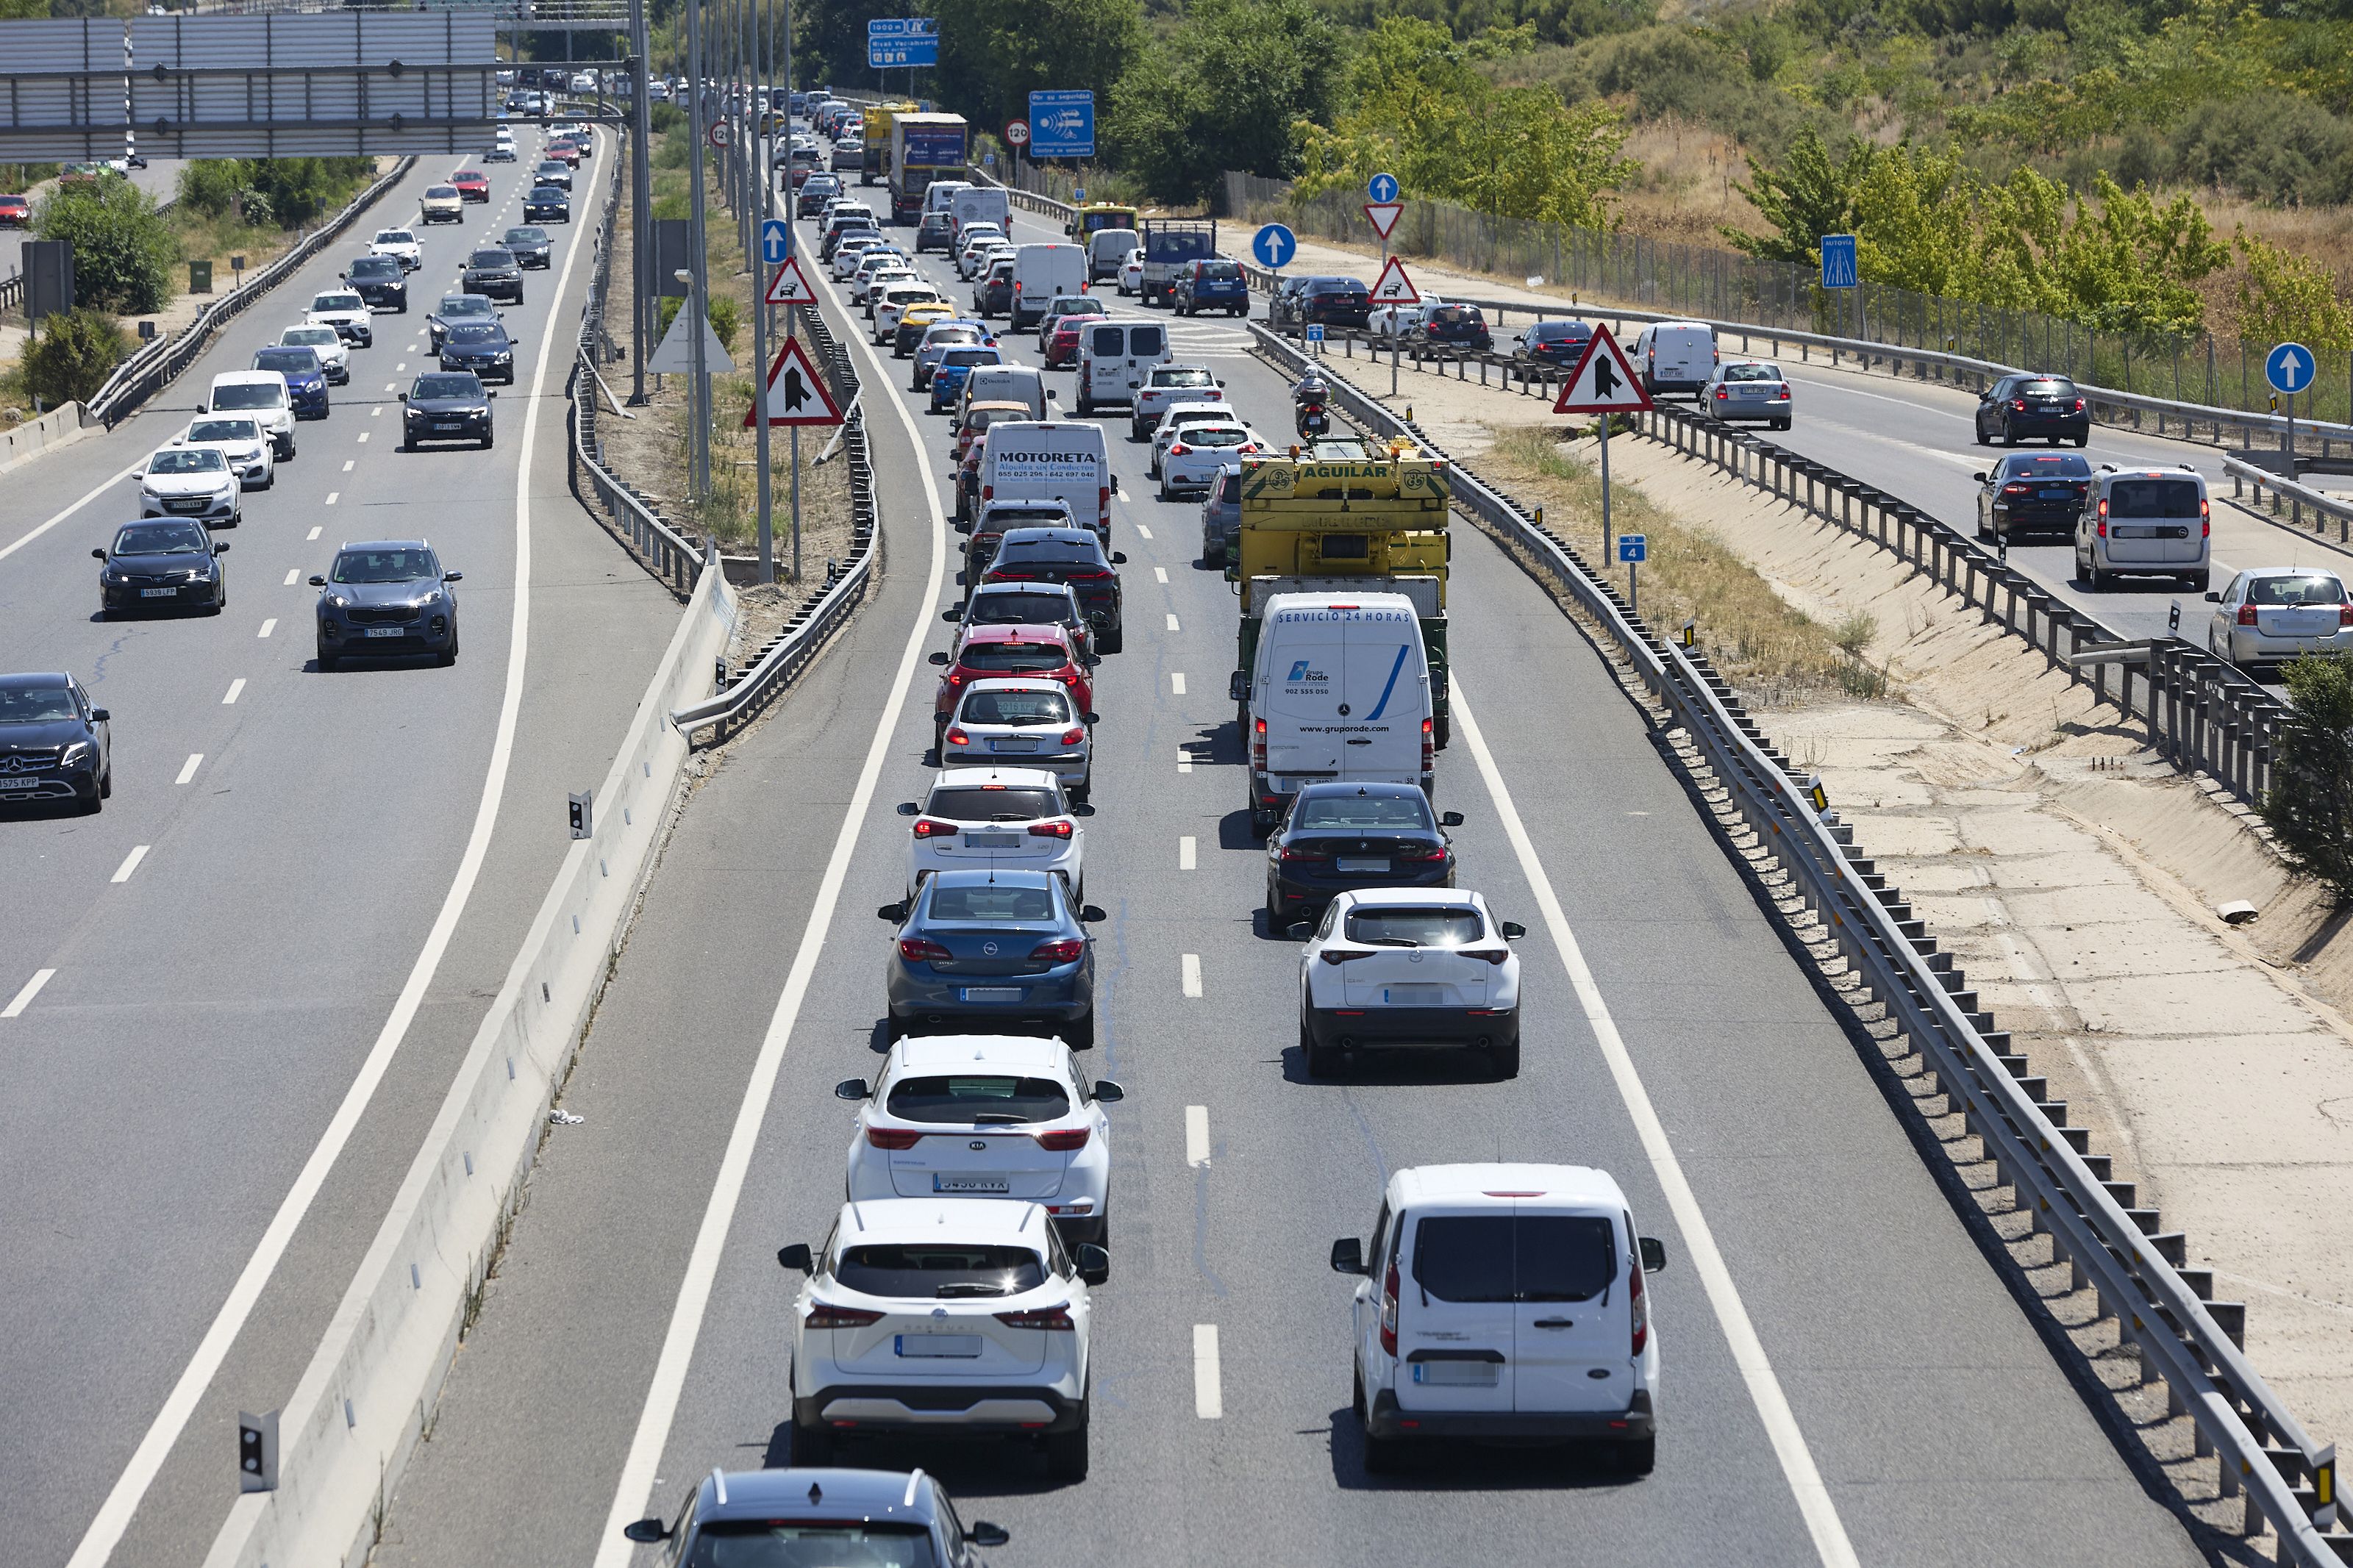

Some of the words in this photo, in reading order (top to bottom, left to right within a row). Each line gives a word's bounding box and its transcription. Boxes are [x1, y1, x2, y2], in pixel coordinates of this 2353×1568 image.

[1059, 93, 1090, 101] seguridad
[715, 130, 728, 139] 12
[1009, 129, 1027, 137] 120
[1825, 238, 1852, 246] AUTOVÍA
[1000, 452, 1096, 463] MOTORETA
[1304, 466, 1388, 478] AGUILAR
[1627, 548, 1637, 558] 4
[1278, 612, 1340, 623] SERVICIO
[1346, 612, 1360, 621] 24
[1365, 612, 1410, 623] HORAS
[1299, 725, 1389, 734] www.gruporode.com
[21, 778, 37, 787] KPP
